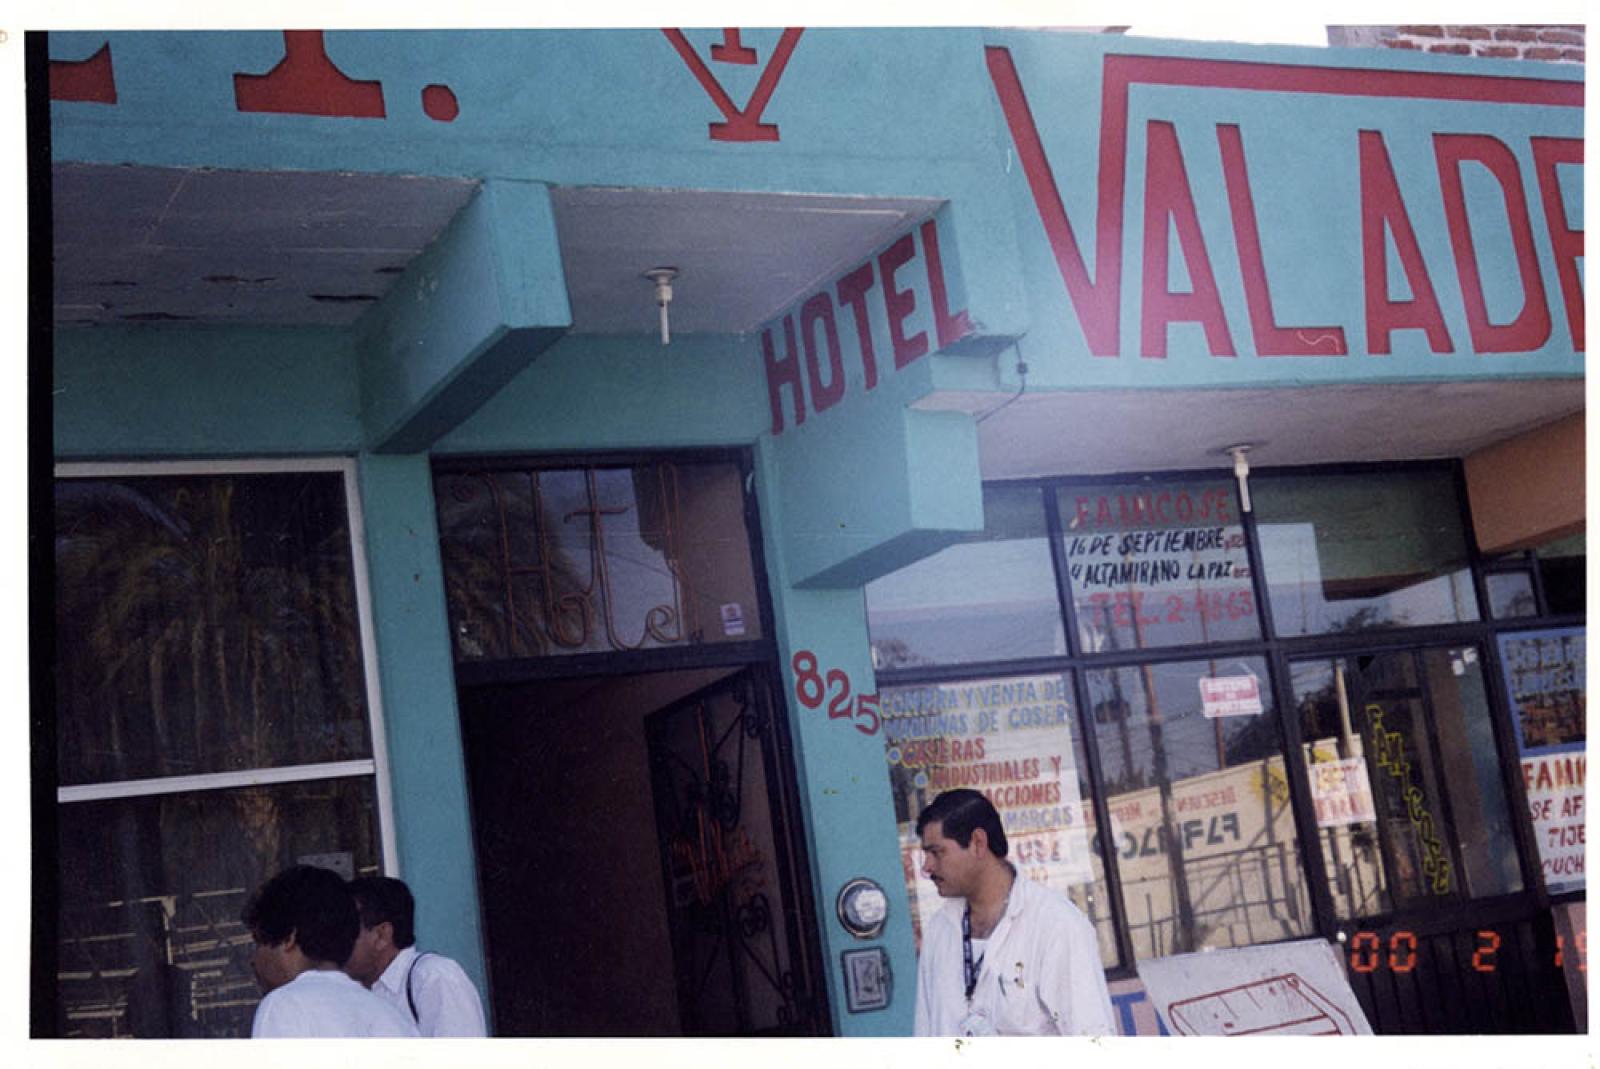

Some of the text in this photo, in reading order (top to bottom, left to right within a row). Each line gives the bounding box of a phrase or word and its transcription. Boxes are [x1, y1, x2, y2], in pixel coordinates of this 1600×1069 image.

[762, 219, 976, 435] HOTEL
[1070, 537, 1087, 557] 16
[1088, 535, 1114, 556] DE
[1118, 528, 1224, 556] SEPTIEMBRE
[1083, 560, 1179, 588] ALTAMIRANO
[1186, 563, 1204, 580] LA
[1206, 561, 1233, 580] PAZ
[792, 650, 881, 736] 825
[976, 682, 1037, 707] VENTA
[1044, 679, 1069, 700] DE
[977, 710, 1000, 734] DE
[902, 738, 986, 767] CASERAS
[931, 755, 1062, 791] INDUSTRIALES Y
[1520, 757, 1586, 791] FAMI
[987, 781, 1062, 810] ACCIONES
[1530, 795, 1585, 822] SE AF
[1008, 806, 1073, 830] MARCAS
